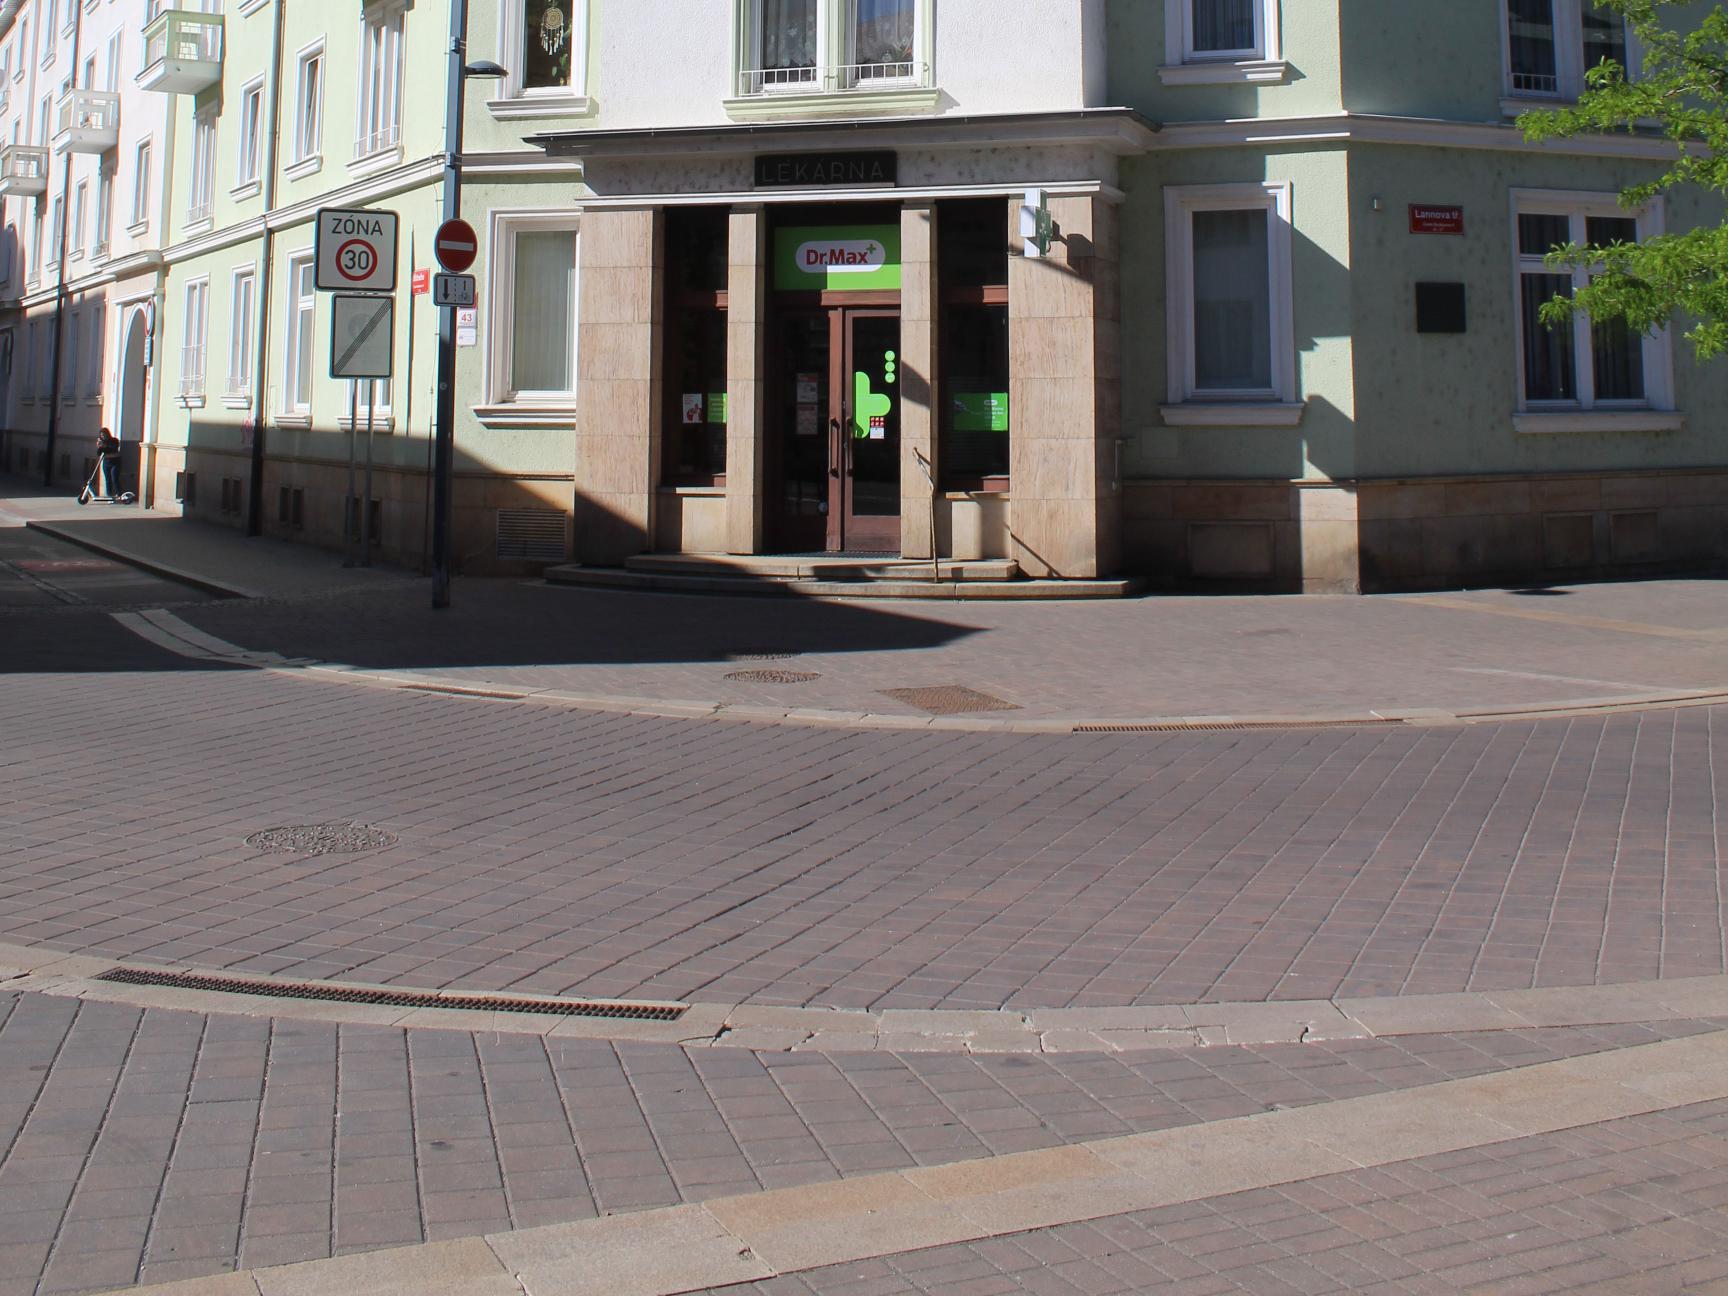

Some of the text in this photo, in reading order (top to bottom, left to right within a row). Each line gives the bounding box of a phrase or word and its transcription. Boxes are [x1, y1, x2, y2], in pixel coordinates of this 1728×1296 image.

[761, 158, 884, 182] LÉKÁRNA
[332, 215, 383, 236] ZÓNA
[344, 250, 370, 270] 30
[461, 313, 472, 322] 43
